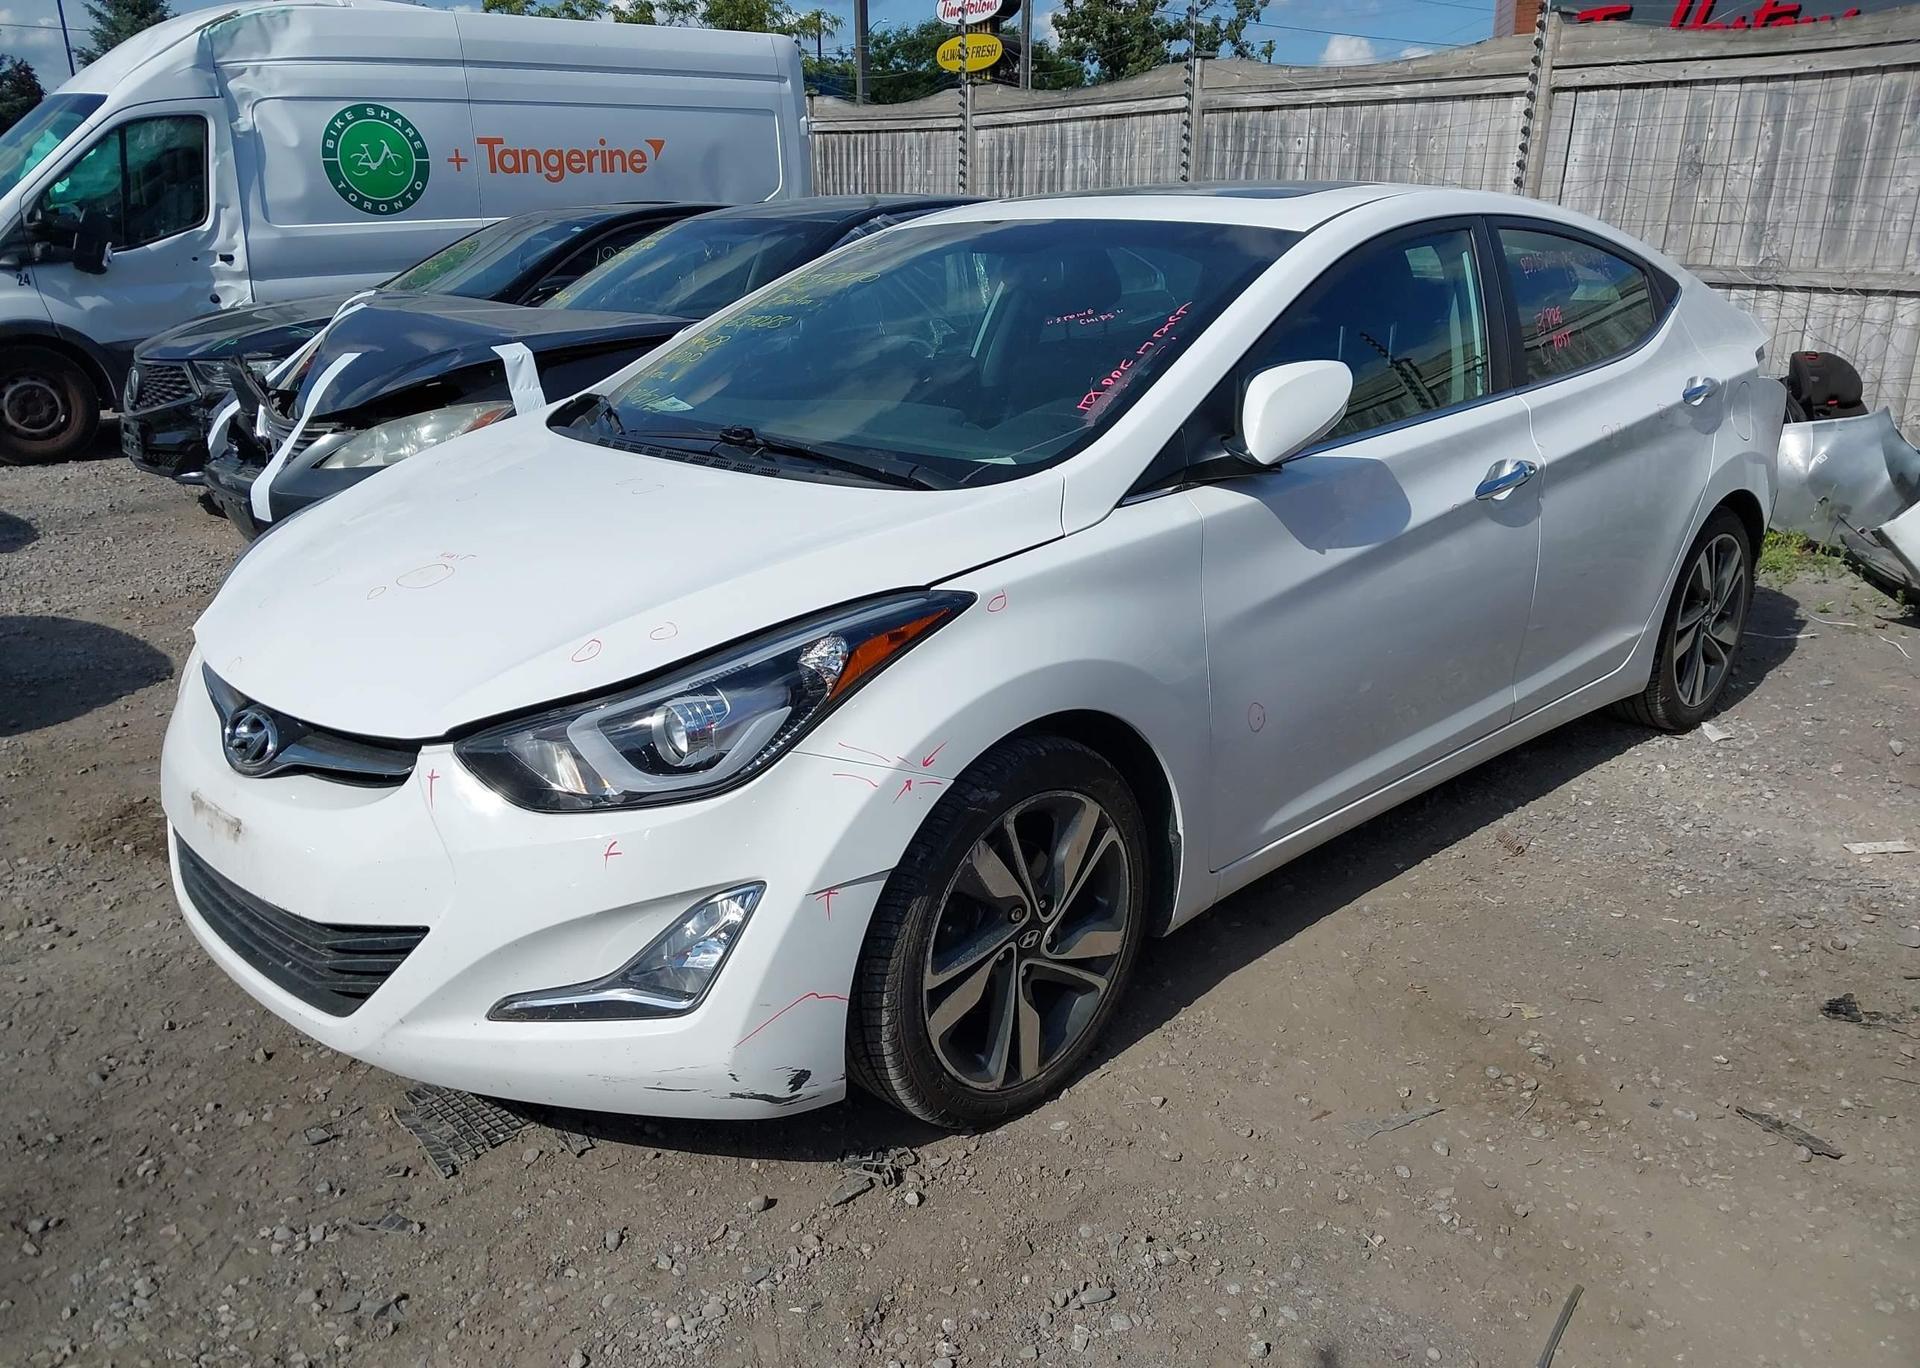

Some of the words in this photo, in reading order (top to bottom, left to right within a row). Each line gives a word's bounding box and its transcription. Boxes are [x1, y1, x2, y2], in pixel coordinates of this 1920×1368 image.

[941, 46, 969, 61] ALWAS
[971, 44, 997, 59] FRESH
[326, 111, 355, 149] BIKE
[366, 107, 423, 151] SHARE
[476, 137, 648, 183] Tangerine
[337, 181, 423, 208] TORONTO
[16, 272, 31, 287] 24
